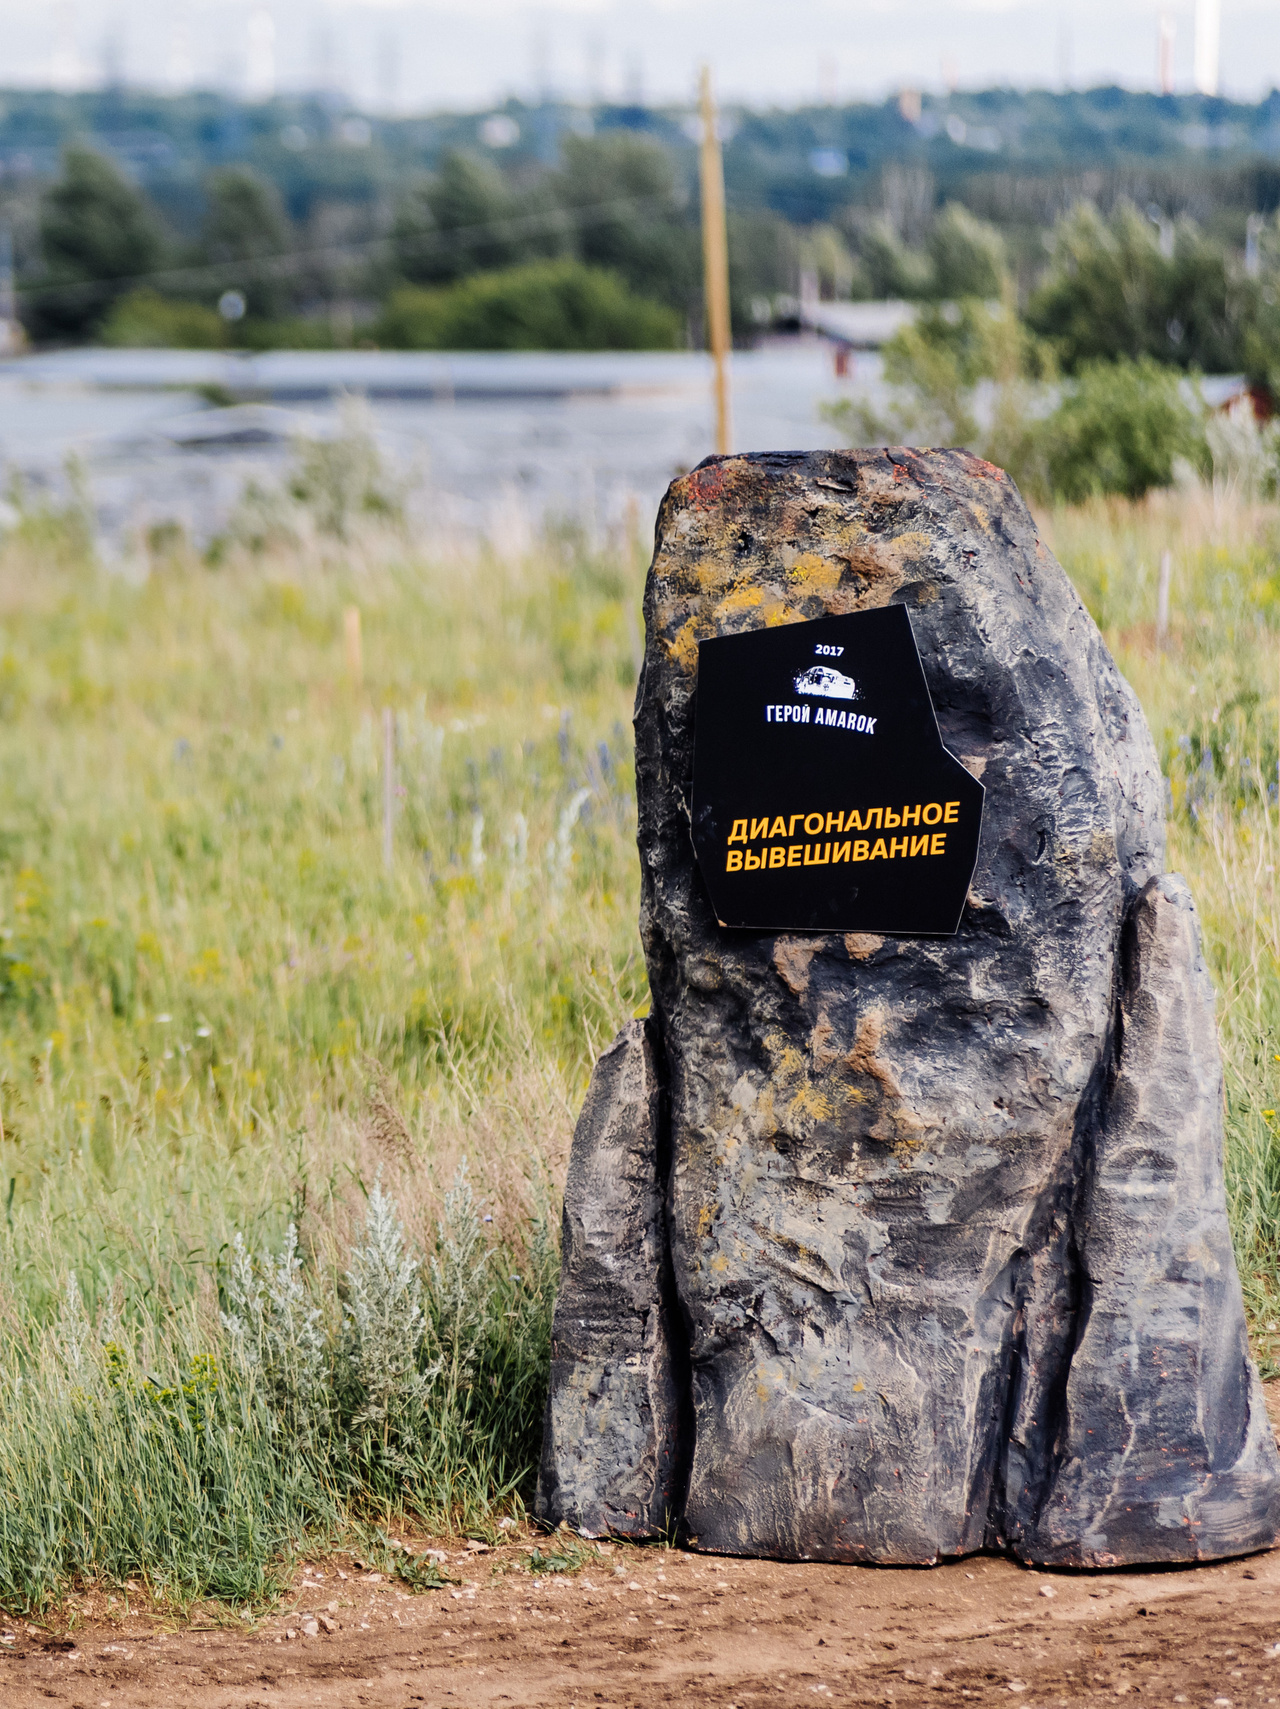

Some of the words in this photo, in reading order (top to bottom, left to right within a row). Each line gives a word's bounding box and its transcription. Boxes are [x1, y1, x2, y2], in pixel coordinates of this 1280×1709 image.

[815, 644, 844, 657] 2017
[766, 704, 810, 723] ГЕРОЙ
[814, 707, 877, 735] AMAROK
[727, 801, 960, 845] ДИАГОНАЛЬНОЕ
[726, 833, 947, 872] ВЫВЕШИВАНИЕ
